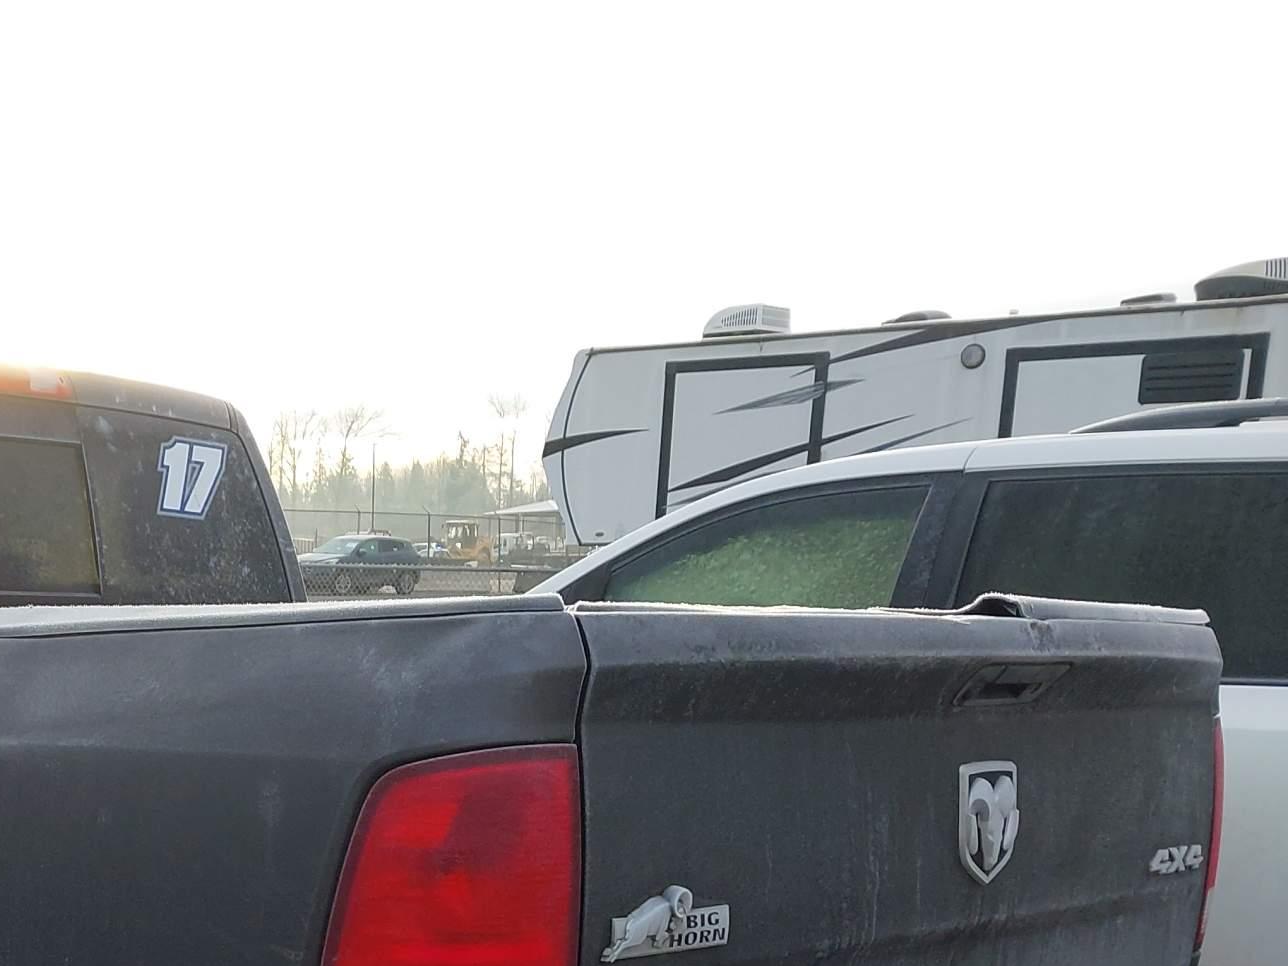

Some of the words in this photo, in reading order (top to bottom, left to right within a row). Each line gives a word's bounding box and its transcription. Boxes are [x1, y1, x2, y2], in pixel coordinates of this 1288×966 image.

[158, 437, 226, 518] 17
[686, 911, 720, 929] BIG
[669, 927, 726, 948] HORN
